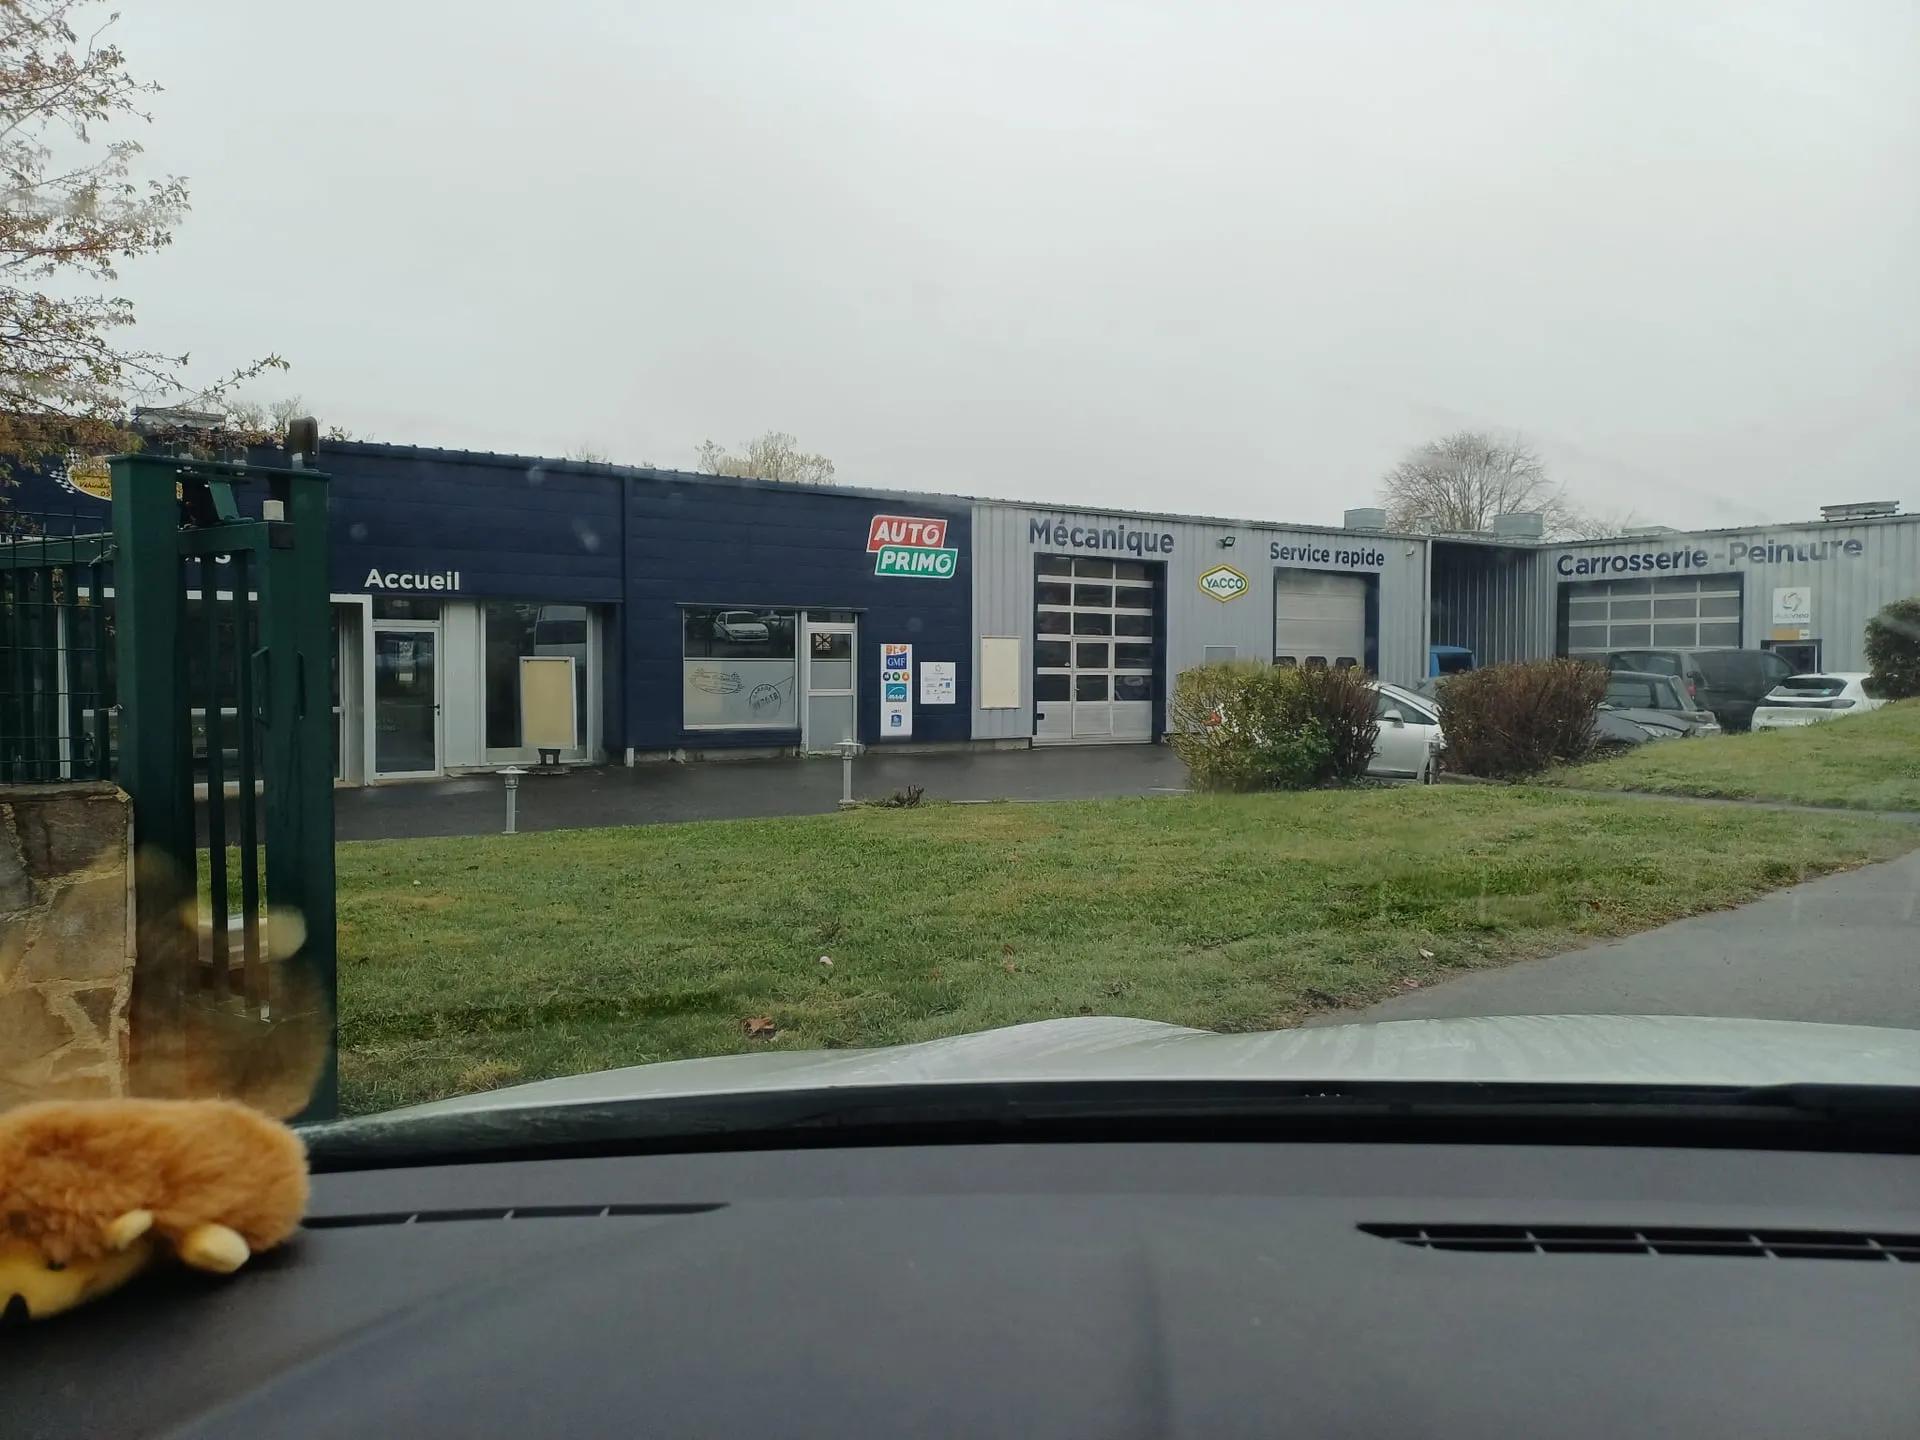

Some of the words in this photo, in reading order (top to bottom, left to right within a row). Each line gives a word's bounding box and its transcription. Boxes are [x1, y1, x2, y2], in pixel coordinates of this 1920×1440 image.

[874, 520, 940, 545] AUTO
[1029, 517, 1175, 557] Mécanique
[881, 551, 951, 573] PRIMO
[1270, 541, 1330, 563] Service
[1335, 547, 1385, 568] rapide
[364, 568, 460, 591] Accueil
[1205, 577, 1243, 589] YACCO
[887, 657, 905, 667] GMF
